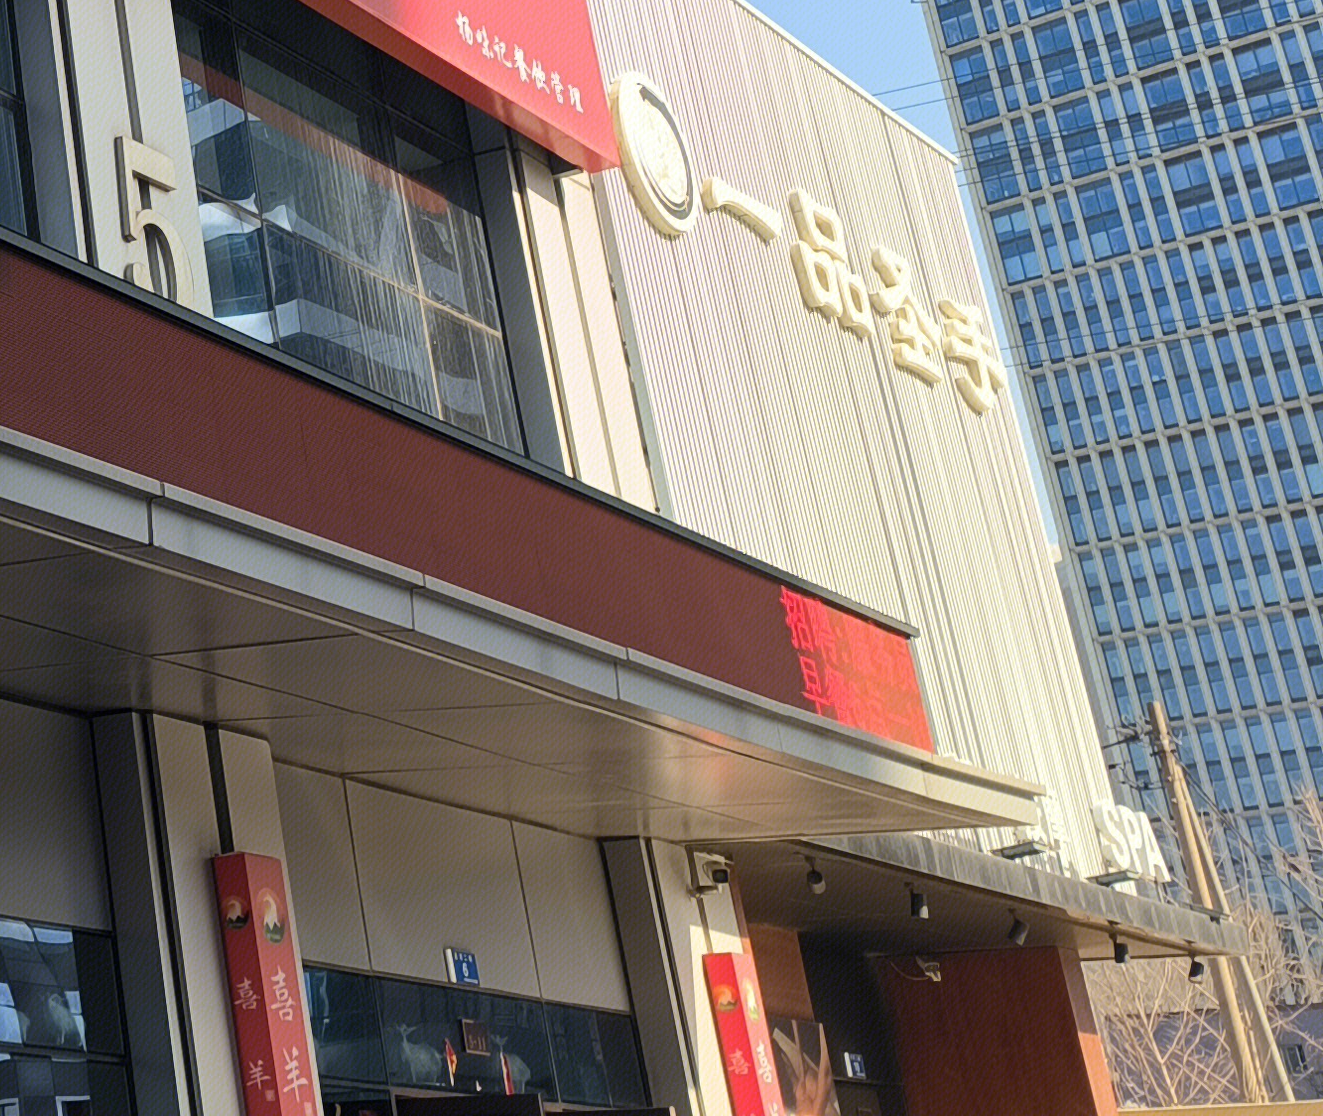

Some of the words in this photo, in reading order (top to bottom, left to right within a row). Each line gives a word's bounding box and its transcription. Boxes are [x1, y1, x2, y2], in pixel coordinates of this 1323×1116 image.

[700, 175, 1005, 416] 一品圣手
[1093, 803, 1172, 884] SPA
[234, 976, 272, 1090] 喜羊
[270, 965, 309, 1103] 喜羊
